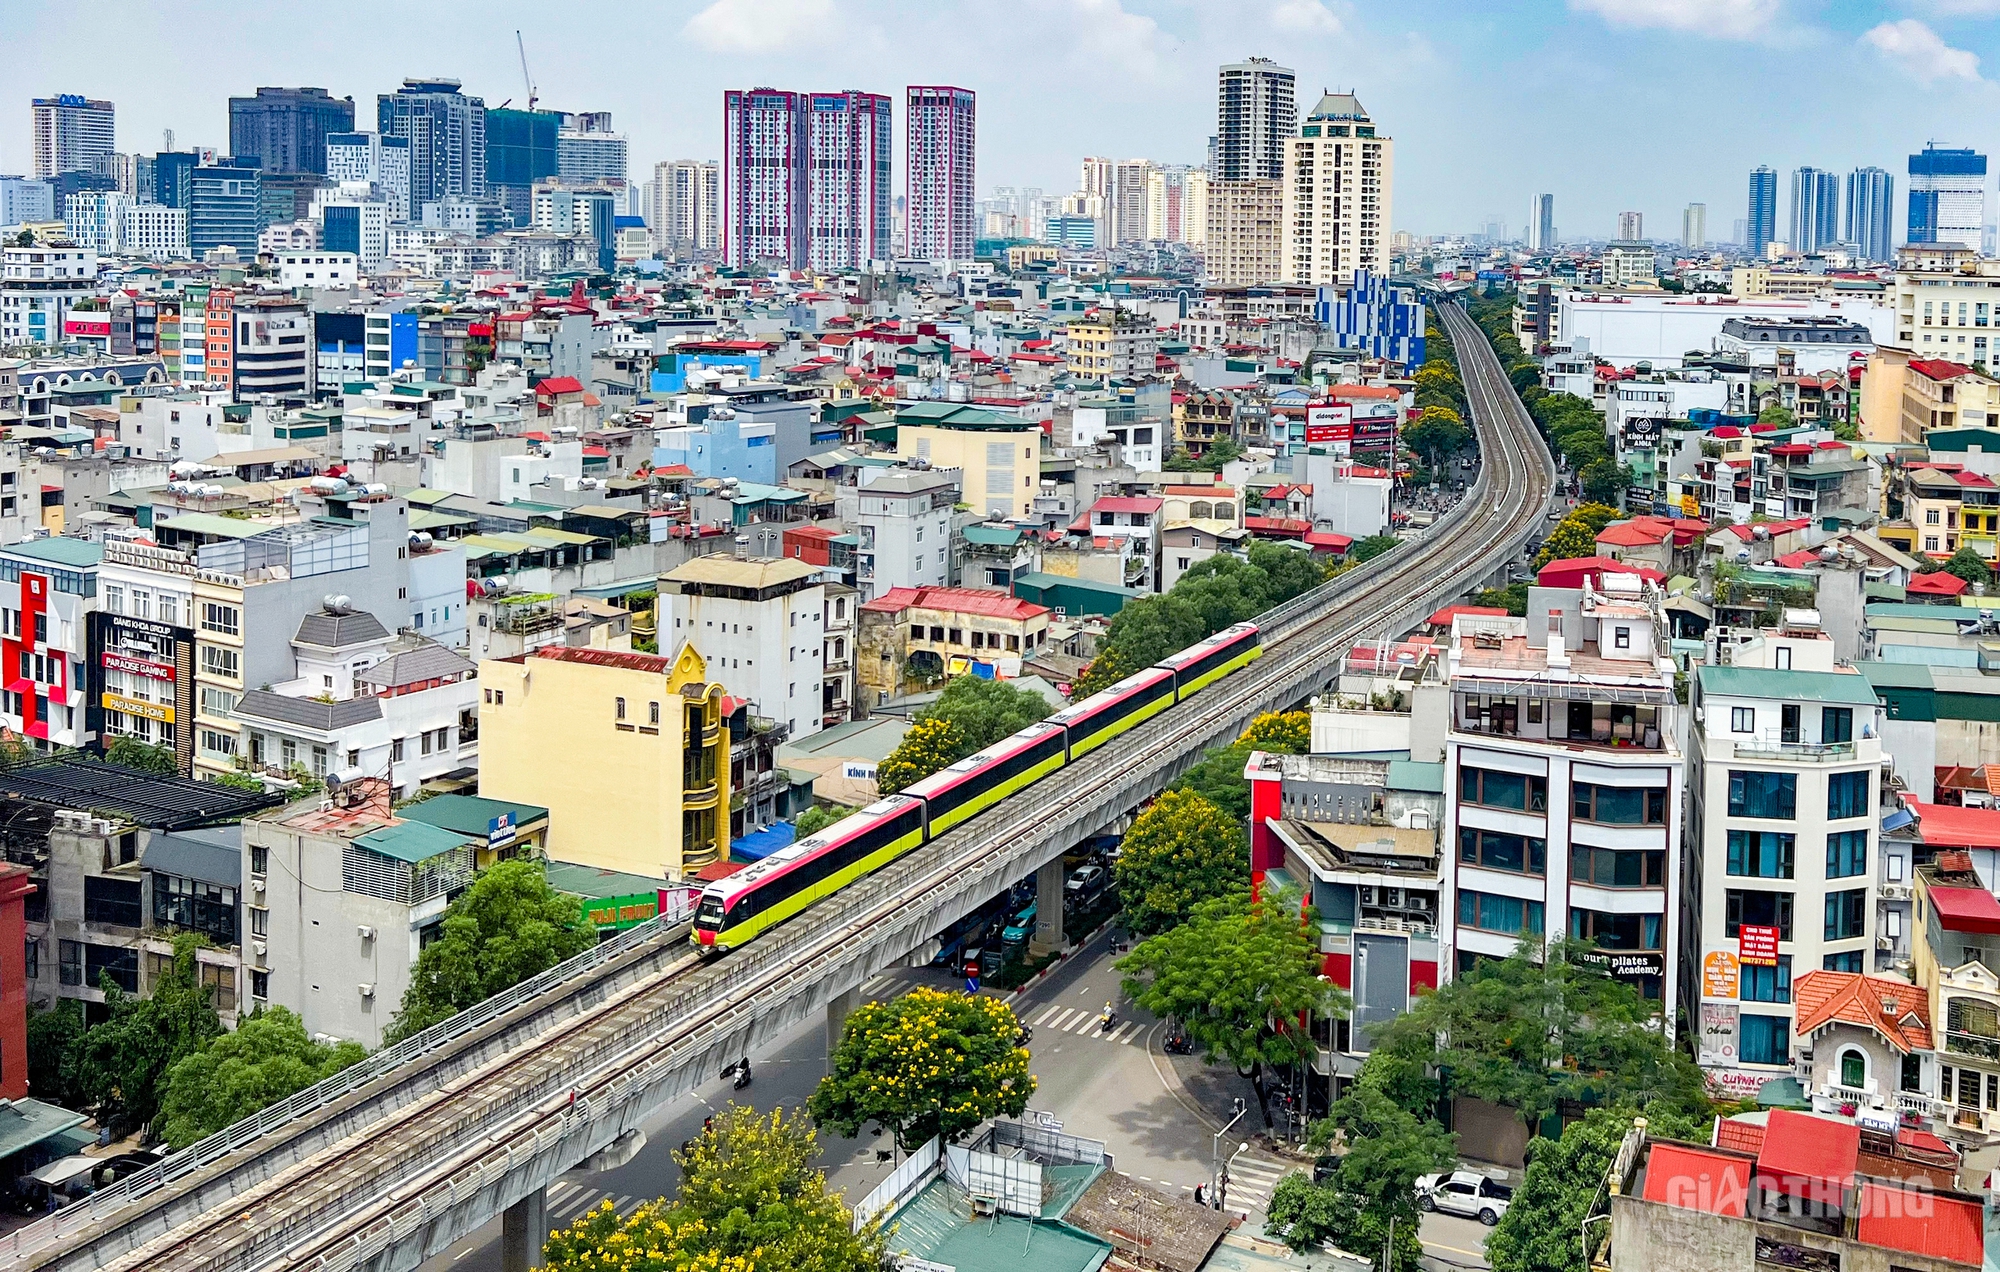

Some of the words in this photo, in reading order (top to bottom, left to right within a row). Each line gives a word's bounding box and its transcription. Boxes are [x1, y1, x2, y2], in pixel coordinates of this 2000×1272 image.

[131, 620, 149, 632] KHOA
[150, 624, 171, 634] GROUP
[106, 657, 140, 671] PARADISE
[140, 664, 167, 677] GAMING
[111, 699, 144, 714] PARADISE
[145, 706, 165, 718] HOME
[847, 767, 866, 778] KÍNH
[589, 906, 616, 924] FUJI
[619, 902, 655, 921] FRUIT
[1612, 956, 1648, 968] pilates
[1617, 965, 1660, 975] Academy
[1722, 1073, 1755, 1085] QUỲNH
